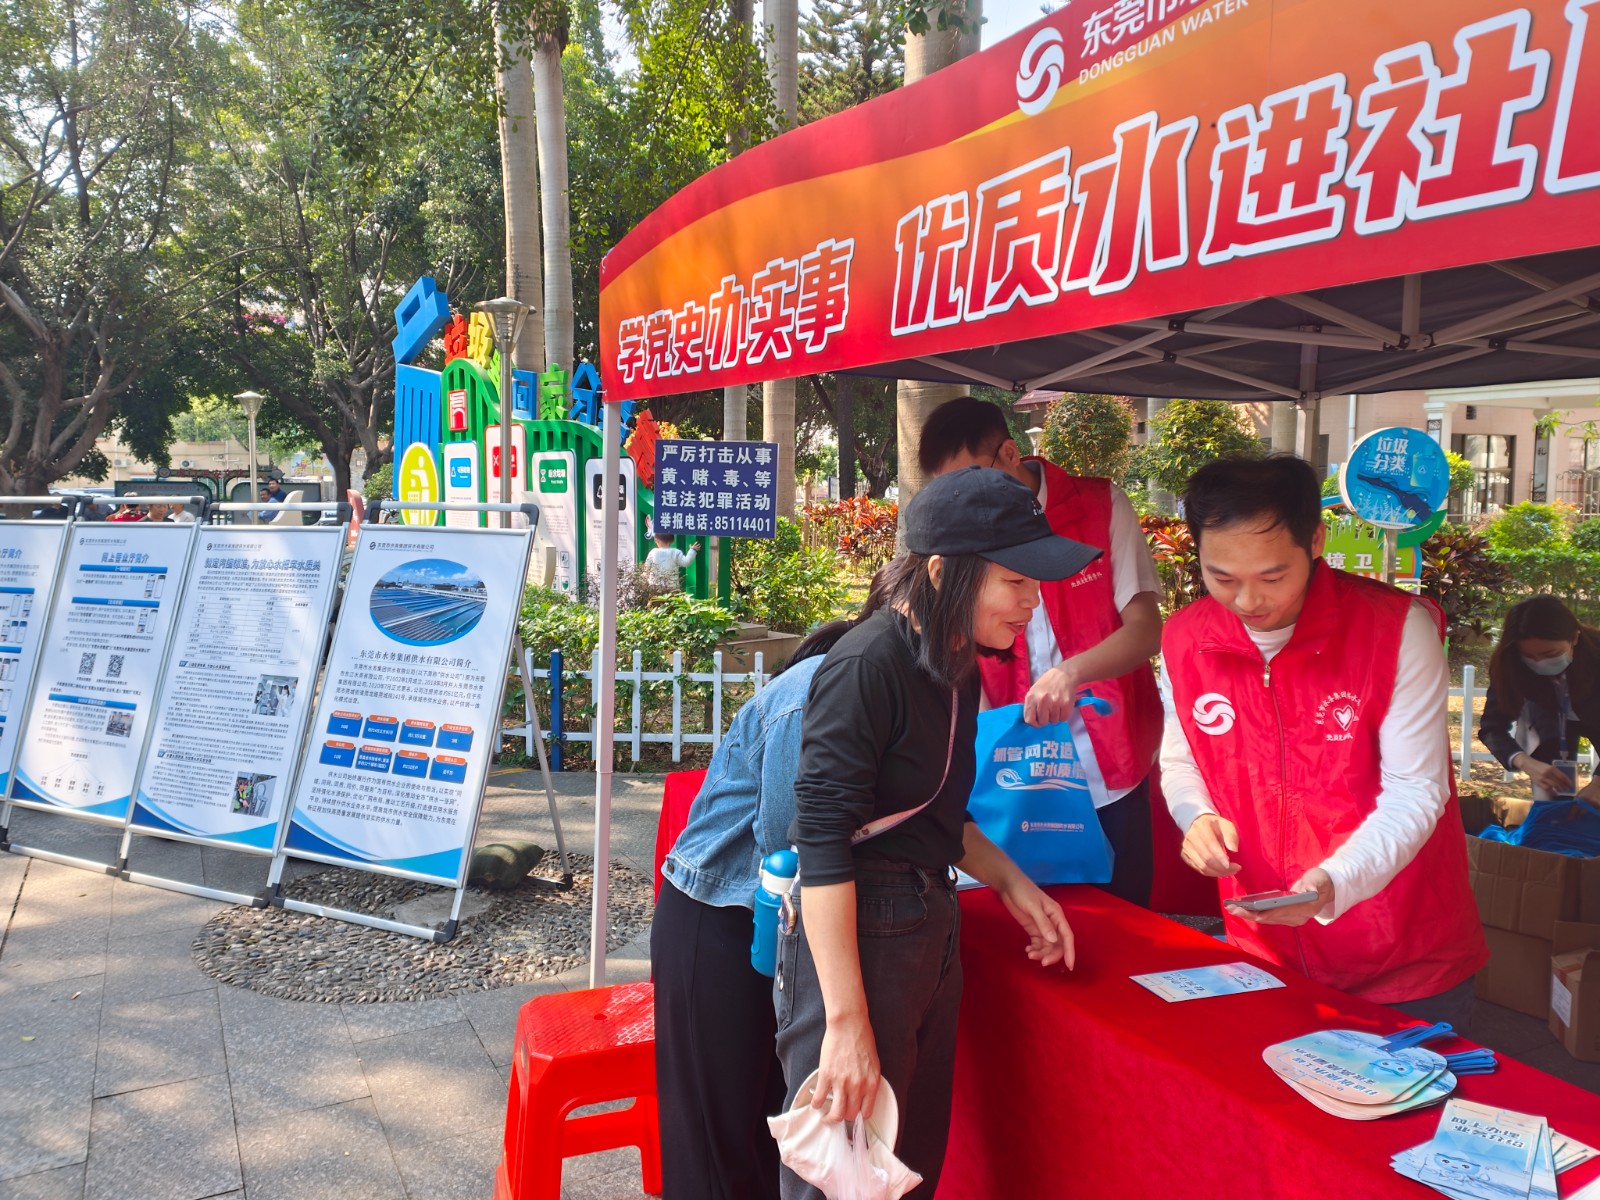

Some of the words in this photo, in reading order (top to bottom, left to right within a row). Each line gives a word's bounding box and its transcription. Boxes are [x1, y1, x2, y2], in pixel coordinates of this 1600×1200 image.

[1079, 26, 1175, 85] DONGGUAN
[1181, 0, 1249, 35] WATER
[617, 238, 855, 383] 学党史办实事
[662, 445, 772, 465] 严厉打击从事
[1376, 436, 1409, 455] 垃圾
[1373, 454, 1406, 473] 分类
[661, 467, 771, 488] 黄、赌、毒、等
[661, 490, 770, 511] 违法犯罪活动
[660, 512, 770, 532] 举报电话:85114401
[360, 649, 472, 669] 东莞市水务集团供水有限公司简介
